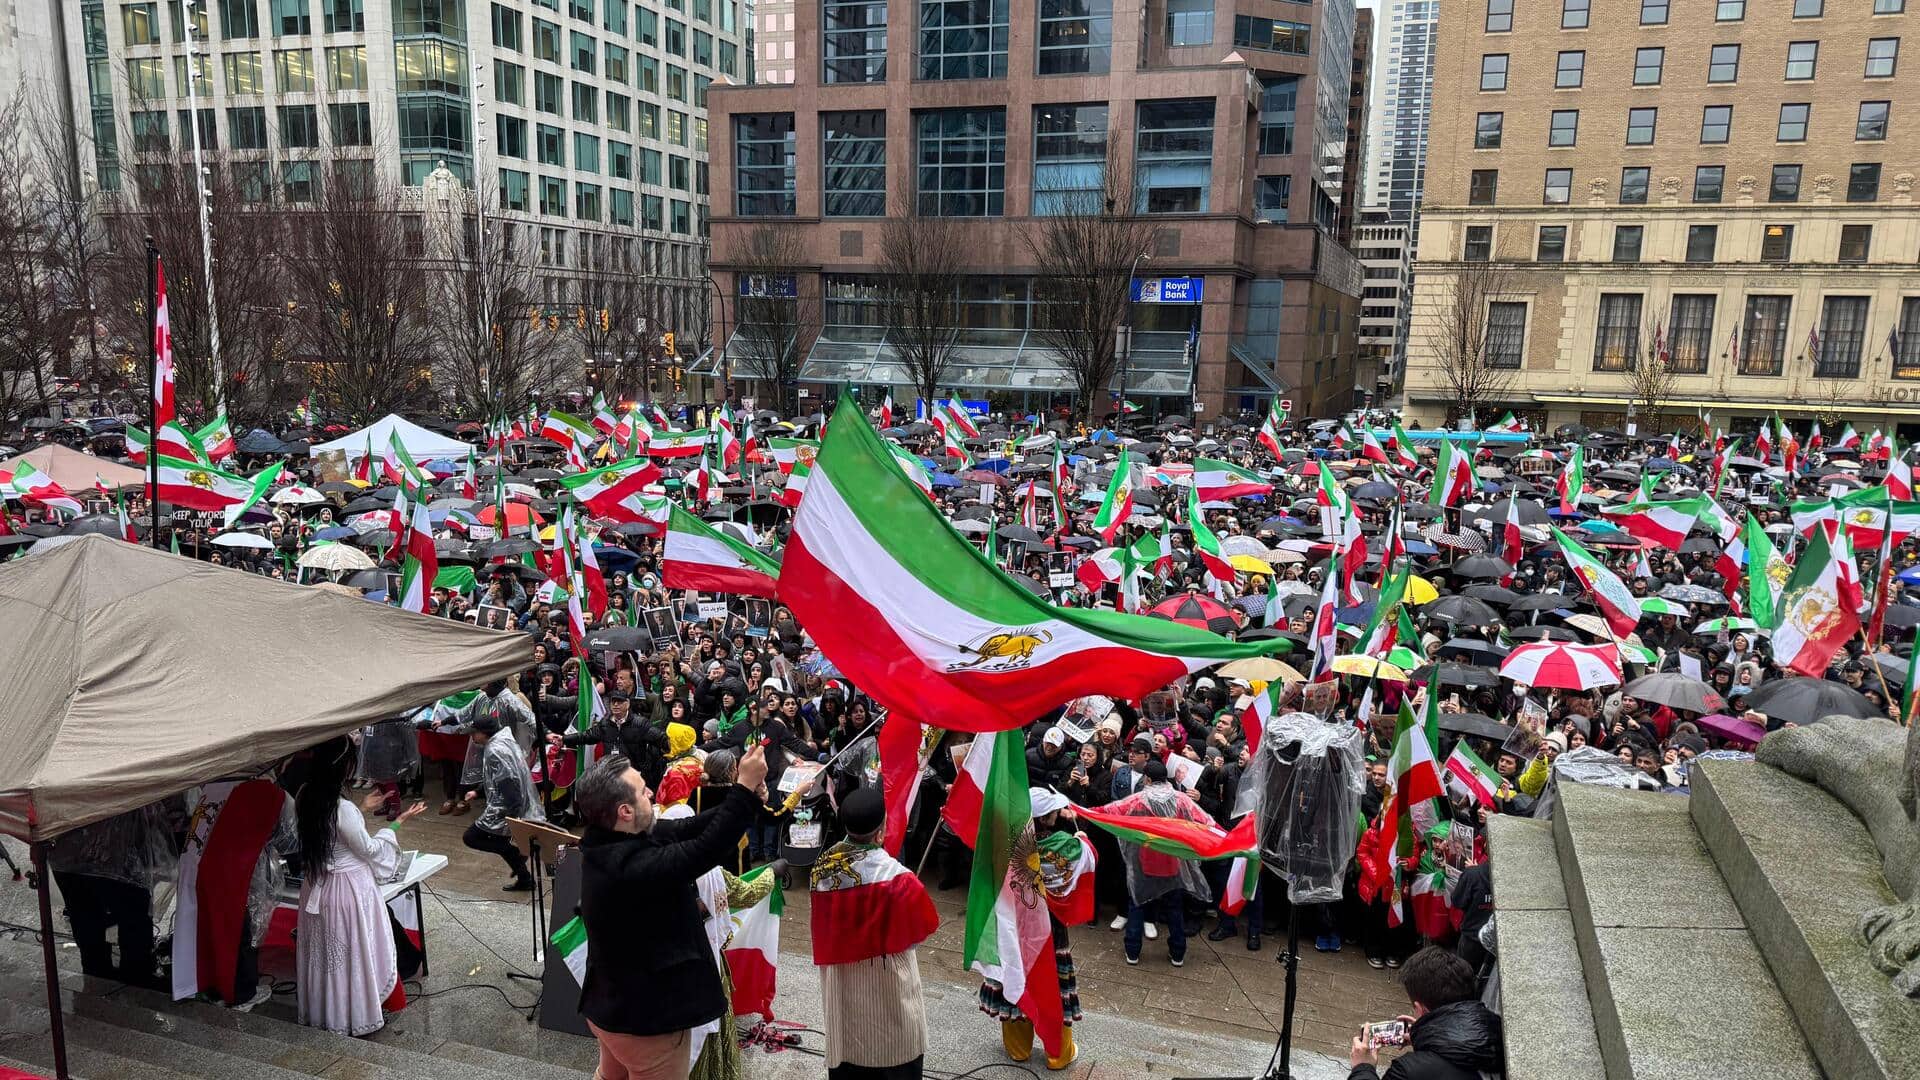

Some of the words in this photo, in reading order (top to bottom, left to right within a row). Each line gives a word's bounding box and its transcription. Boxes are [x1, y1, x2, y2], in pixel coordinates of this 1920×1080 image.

[1165, 281, 1190, 291] Royal
[1165, 290, 1187, 299] Bank
[172, 510, 190, 520] KEEP
[197, 510, 225, 519] WORD
[189, 519, 213, 528] YOUR
